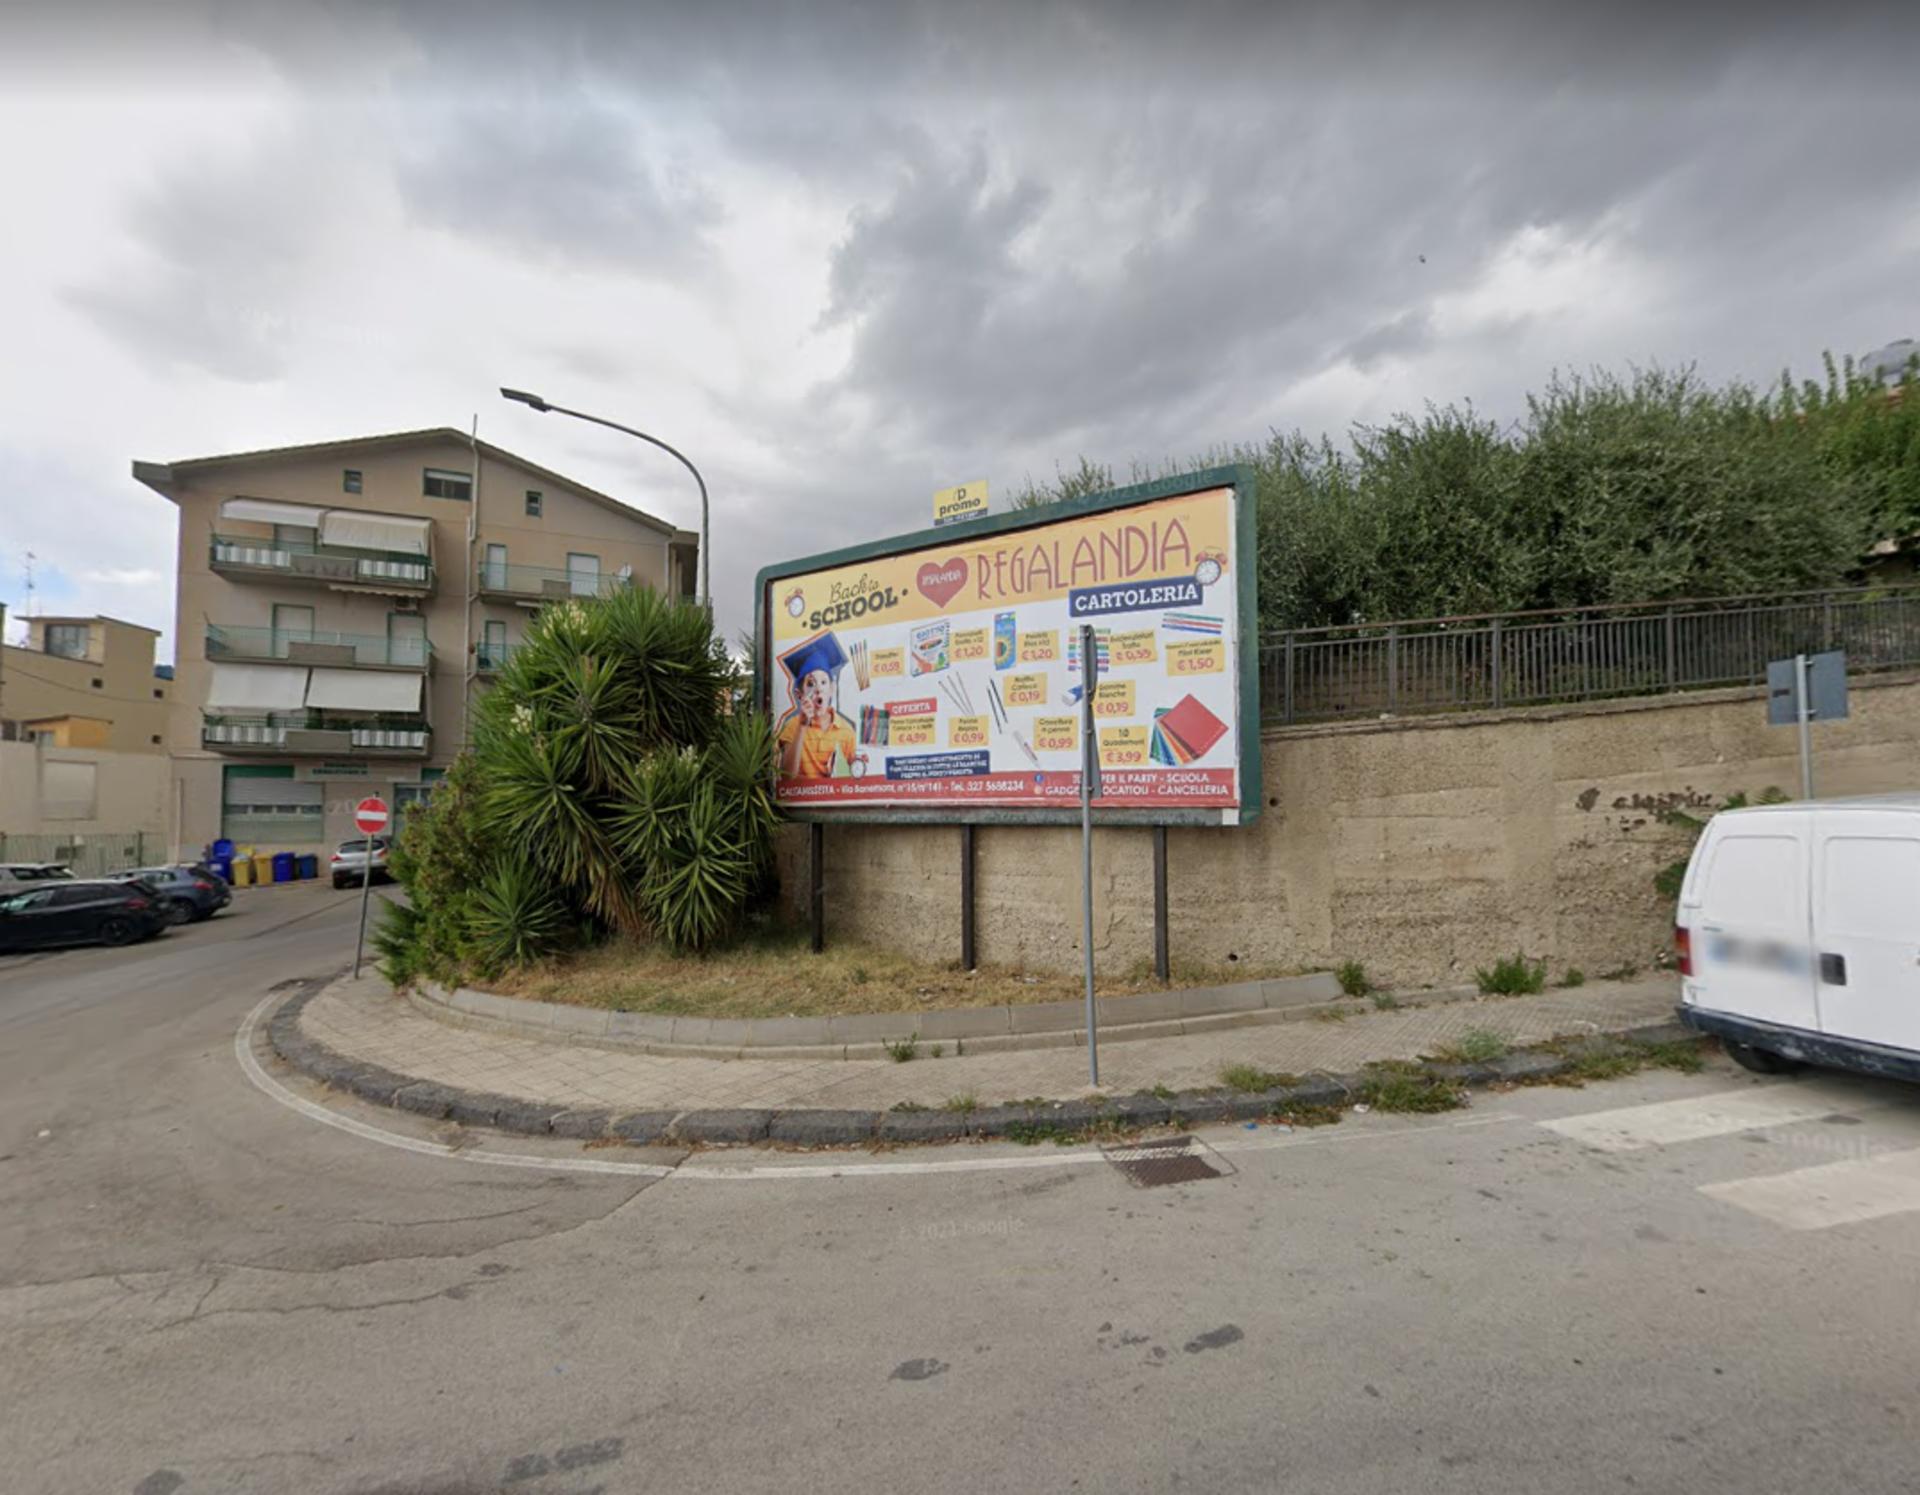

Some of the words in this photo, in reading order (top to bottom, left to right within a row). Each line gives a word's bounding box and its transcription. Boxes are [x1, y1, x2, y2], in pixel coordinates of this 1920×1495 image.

[939, 498, 981, 518] promo
[978, 517, 1191, 600] REGALANDIA
[830, 572, 869, 604] Back
[1074, 583, 1199, 611] CARTOLERIA
[809, 587, 899, 631] SCHOOL
[1048, 738, 1073, 748] 0,99
[1115, 751, 1142, 764] 3,99
[967, 780, 983, 792] 327
[1128, 773, 1157, 783] PARTY
[1166, 773, 1210, 783] SCUOLA
[1157, 784, 1229, 796] CANCELLERIA
